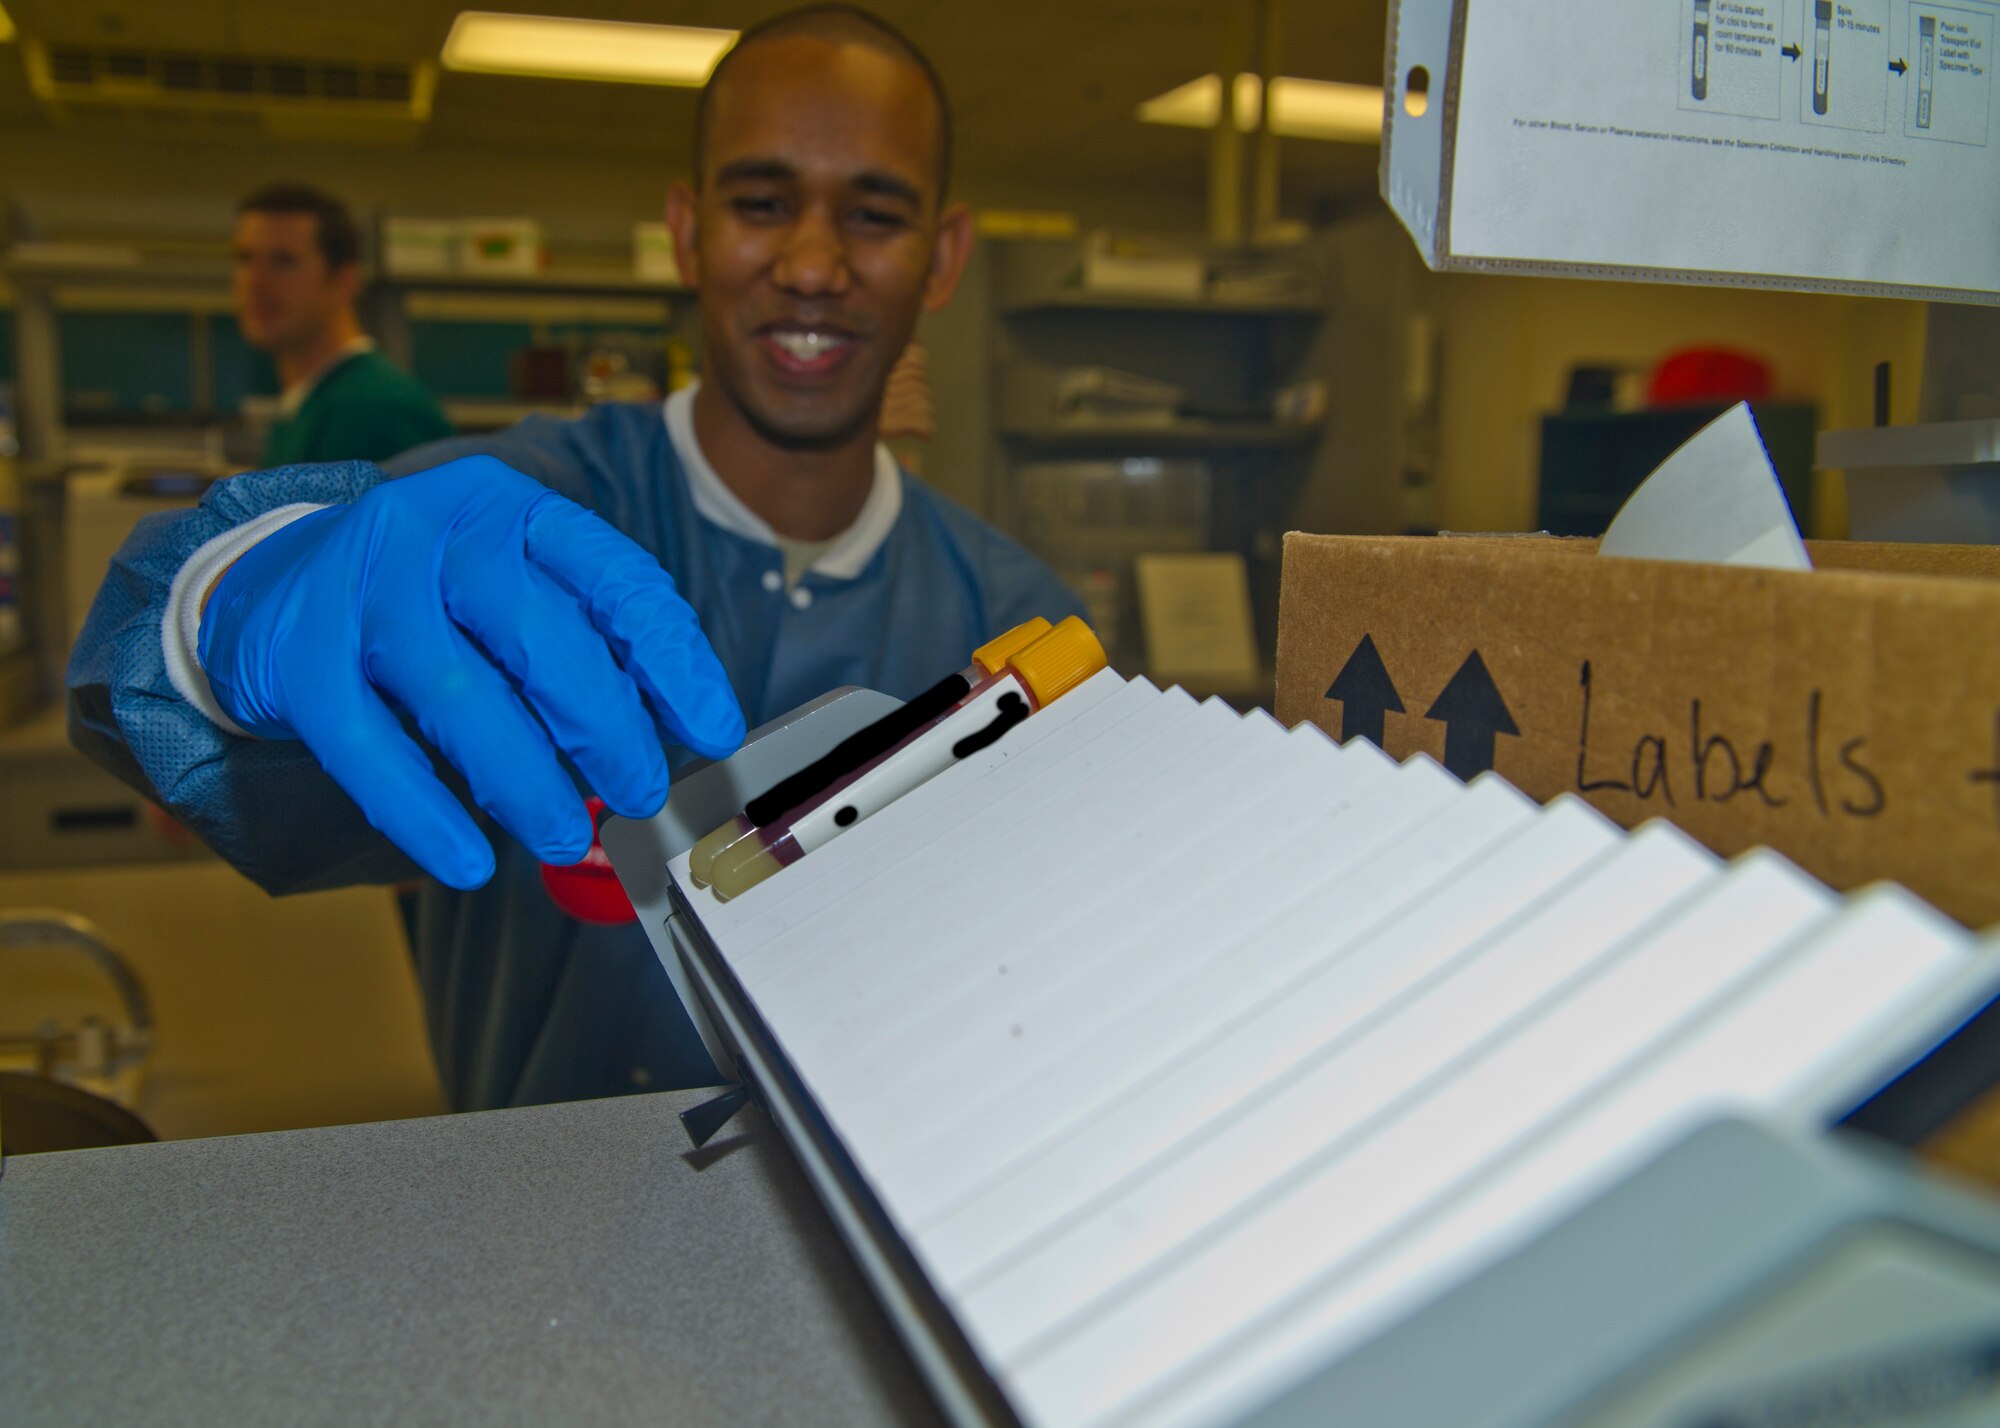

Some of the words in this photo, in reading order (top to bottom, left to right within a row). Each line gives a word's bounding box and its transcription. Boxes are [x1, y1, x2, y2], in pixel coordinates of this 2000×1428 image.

[1837, 4, 1852, 16] Spin
[1837, 18, 1854, 30] 10-15
[1855, 22, 1880, 34] minutes
[1715, 30, 1733, 40] room
[1734, 31, 1775, 45] temperature
[1735, 45, 1762, 57] minutes
[1575, 122, 1598, 132] Serum
[1609, 126, 1633, 136] Plasma
[1724, 139, 1735, 147] the
[1736, 139, 1768, 150] Specimen
[1770, 142, 1800, 153] Collection
[1801, 146, 1812, 155] and
[1814, 148, 1839, 159] Handling
[1841, 151, 1861, 161] section
[1862, 153, 1868, 162] of
[1869, 154, 1880, 163] this
[1578, 659, 1885, 818] Labels
